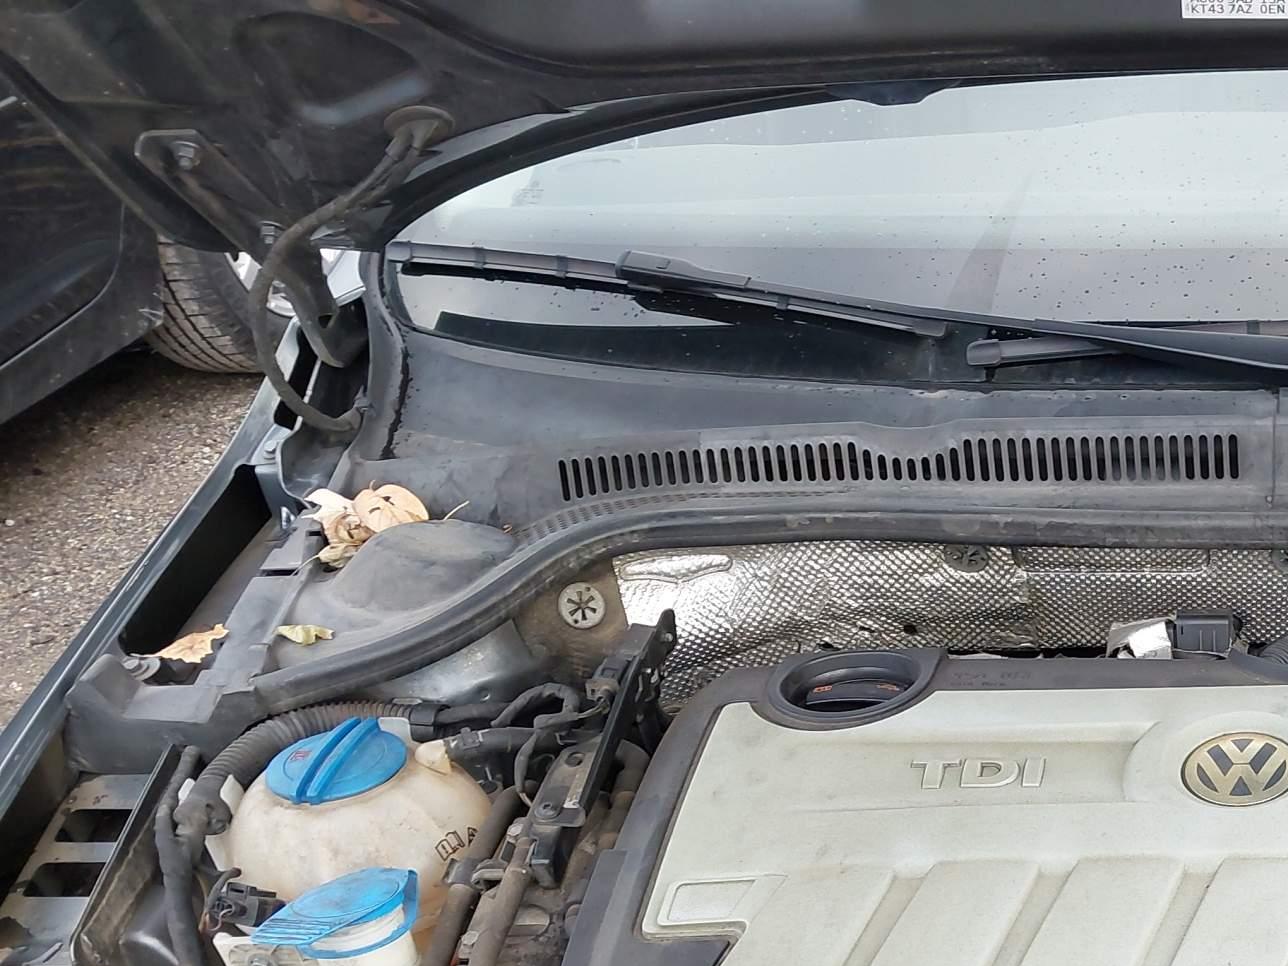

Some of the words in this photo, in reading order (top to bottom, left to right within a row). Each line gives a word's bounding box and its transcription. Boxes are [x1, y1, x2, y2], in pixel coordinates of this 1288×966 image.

[1191, 4, 1225, 14] KT43
[1229, 4, 1253, 14] 7AZ
[910, 757, 1046, 789] TDI
